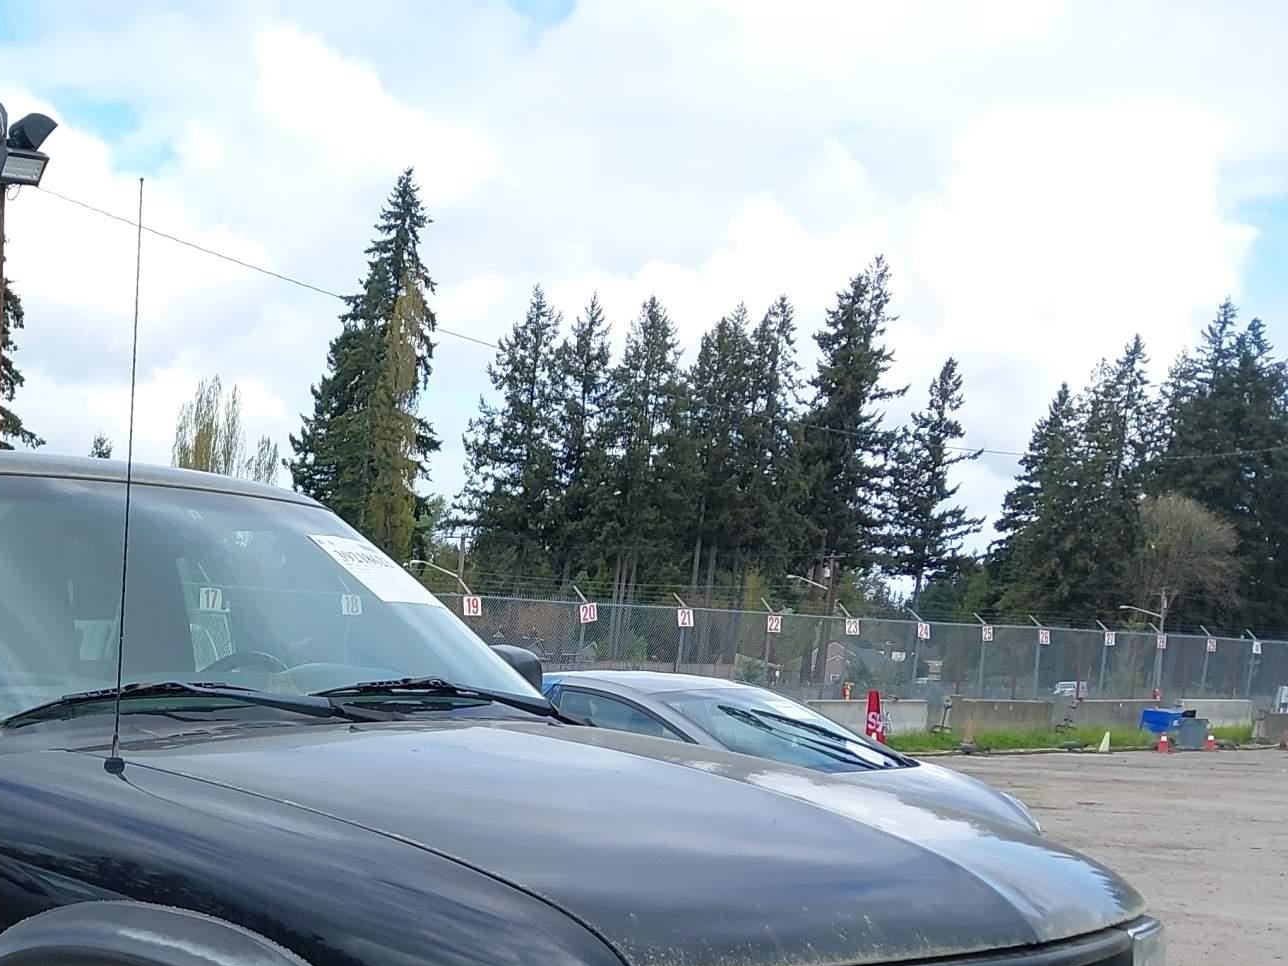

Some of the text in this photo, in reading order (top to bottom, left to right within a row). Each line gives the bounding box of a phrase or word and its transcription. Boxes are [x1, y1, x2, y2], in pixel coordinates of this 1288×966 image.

[204, 590, 219, 609] 17
[465, 598, 479, 614] 19
[582, 604, 595, 621] 20
[680, 610, 692, 625] 21
[769, 617, 780, 631] 22
[847, 621, 858, 634] 23
[919, 624, 929, 637] 24
[983, 628, 993, 640] 25
[1040, 631, 1049, 643] 26
